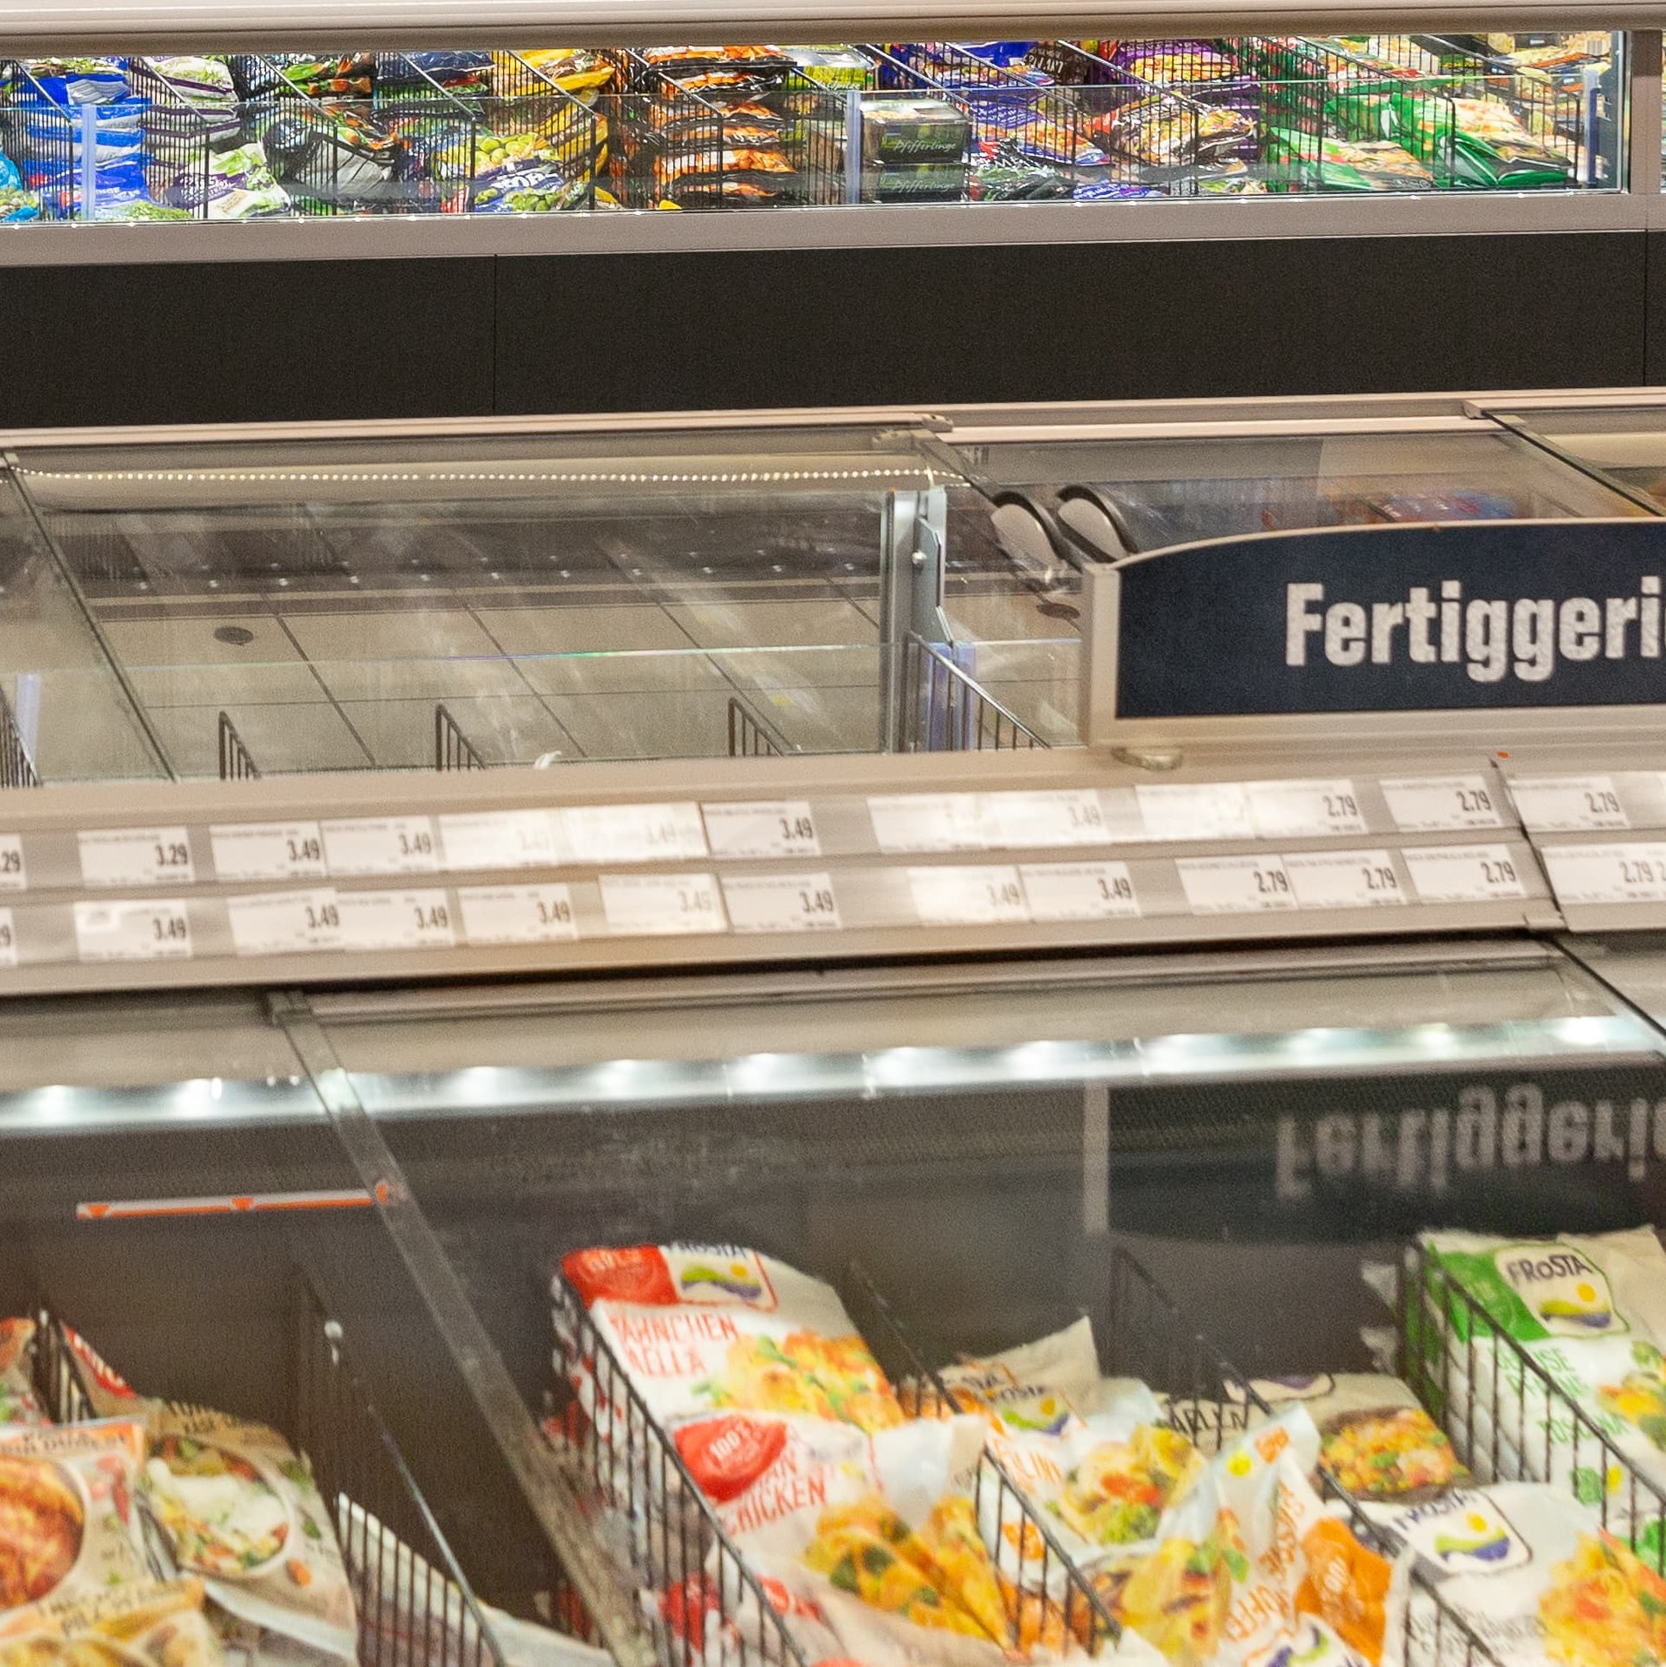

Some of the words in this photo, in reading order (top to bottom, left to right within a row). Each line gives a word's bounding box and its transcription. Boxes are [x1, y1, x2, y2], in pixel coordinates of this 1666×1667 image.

[1322, 793, 1358, 820] 2.79
[1455, 786, 1492, 814] 2.79
[778, 816, 814, 843] 3.49
[155, 843, 190, 869] 3.29
[287, 837, 321, 864] 3.49
[1098, 875, 1134, 902] 3.49
[1252, 868, 1288, 896] 2.79
[800, 887, 837, 915] 3.49
[153, 916, 187, 942] 3.49
[305, 904, 340, 931] 3.49
[415, 904, 449, 932] 3.49
